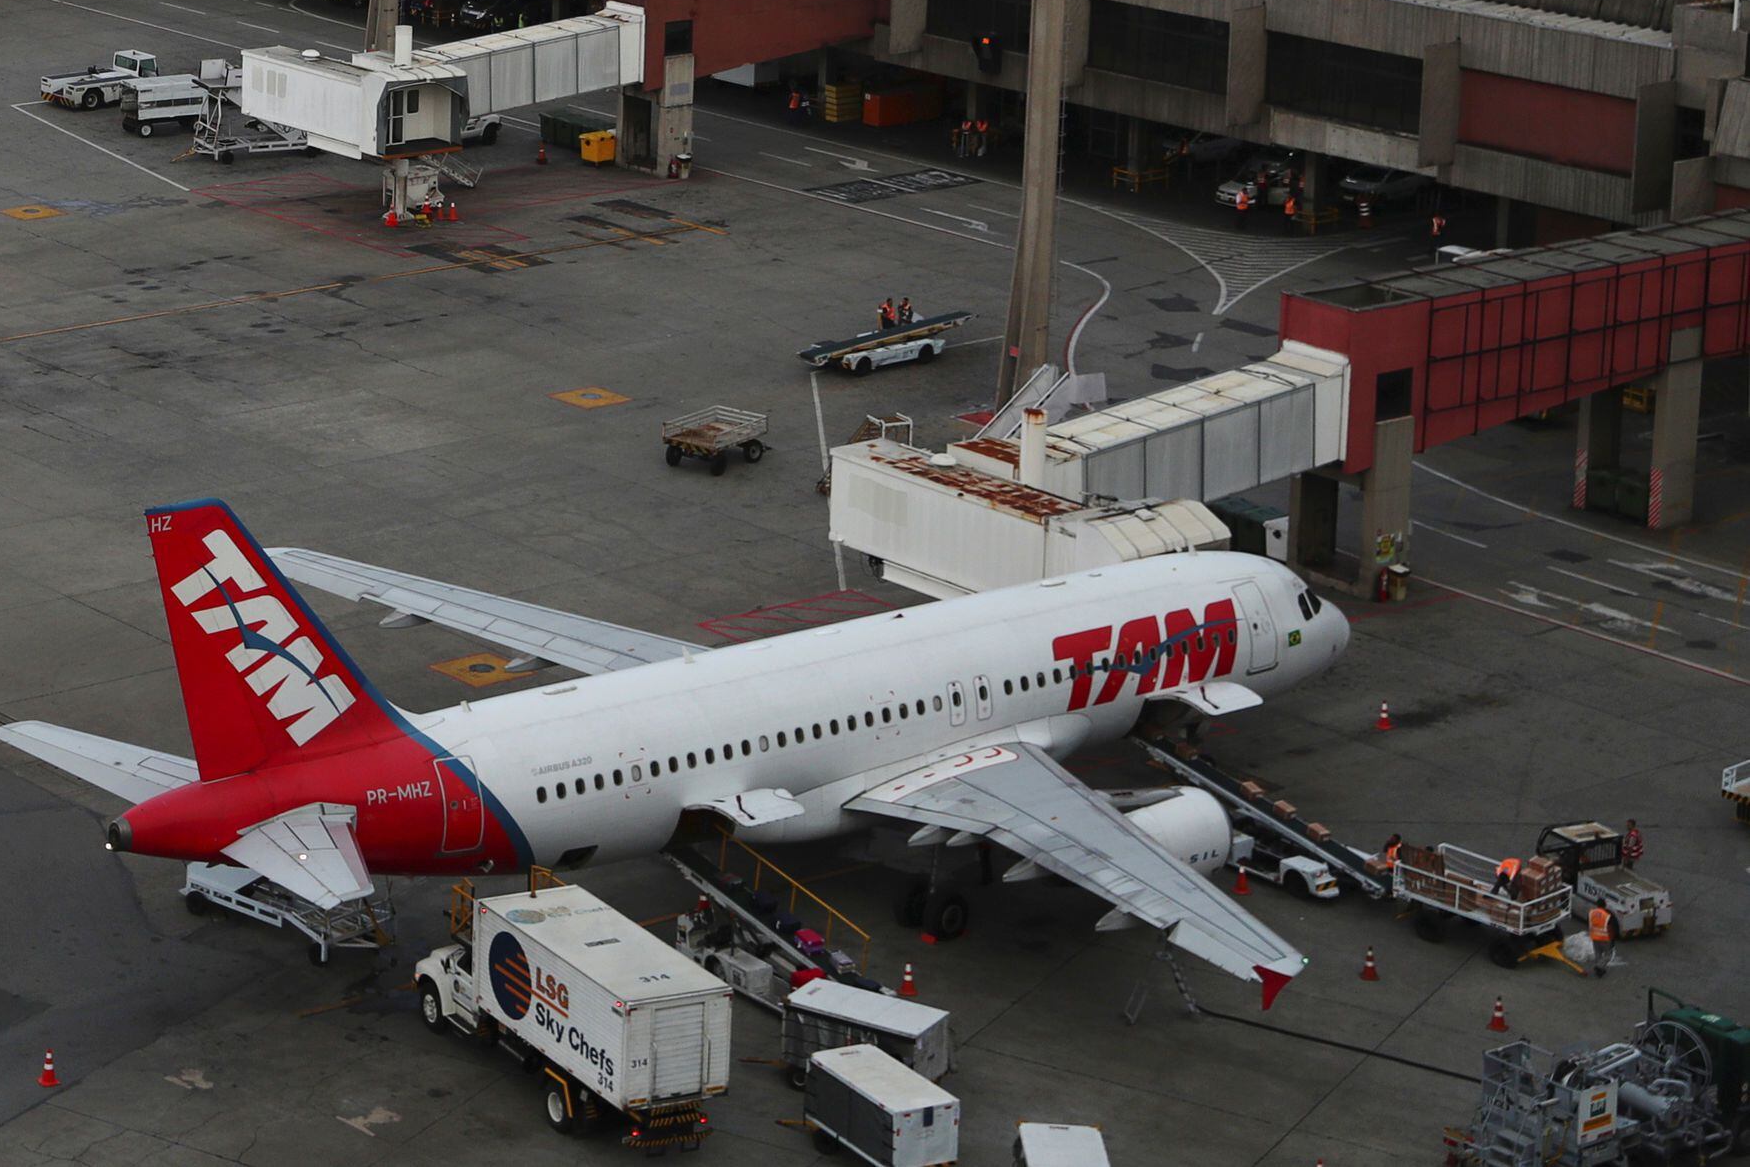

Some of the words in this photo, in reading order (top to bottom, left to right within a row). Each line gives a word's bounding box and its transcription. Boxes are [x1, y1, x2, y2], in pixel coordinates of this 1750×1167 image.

[151, 515, 172, 533] HZ
[170, 528, 357, 748] TAM
[1052, 598, 1238, 712] TAM
[538, 760, 570, 776] AIRBUS
[571, 756, 593, 769] A320
[366, 781, 433, 806] PR-MHZ
[536, 966, 569, 1010] LSG
[638, 973, 671, 984] 314
[535, 1002, 565, 1043] Sky
[568, 1026, 615, 1077] Chefs
[630, 1057, 648, 1069] 314
[597, 1072, 614, 1093] 314
